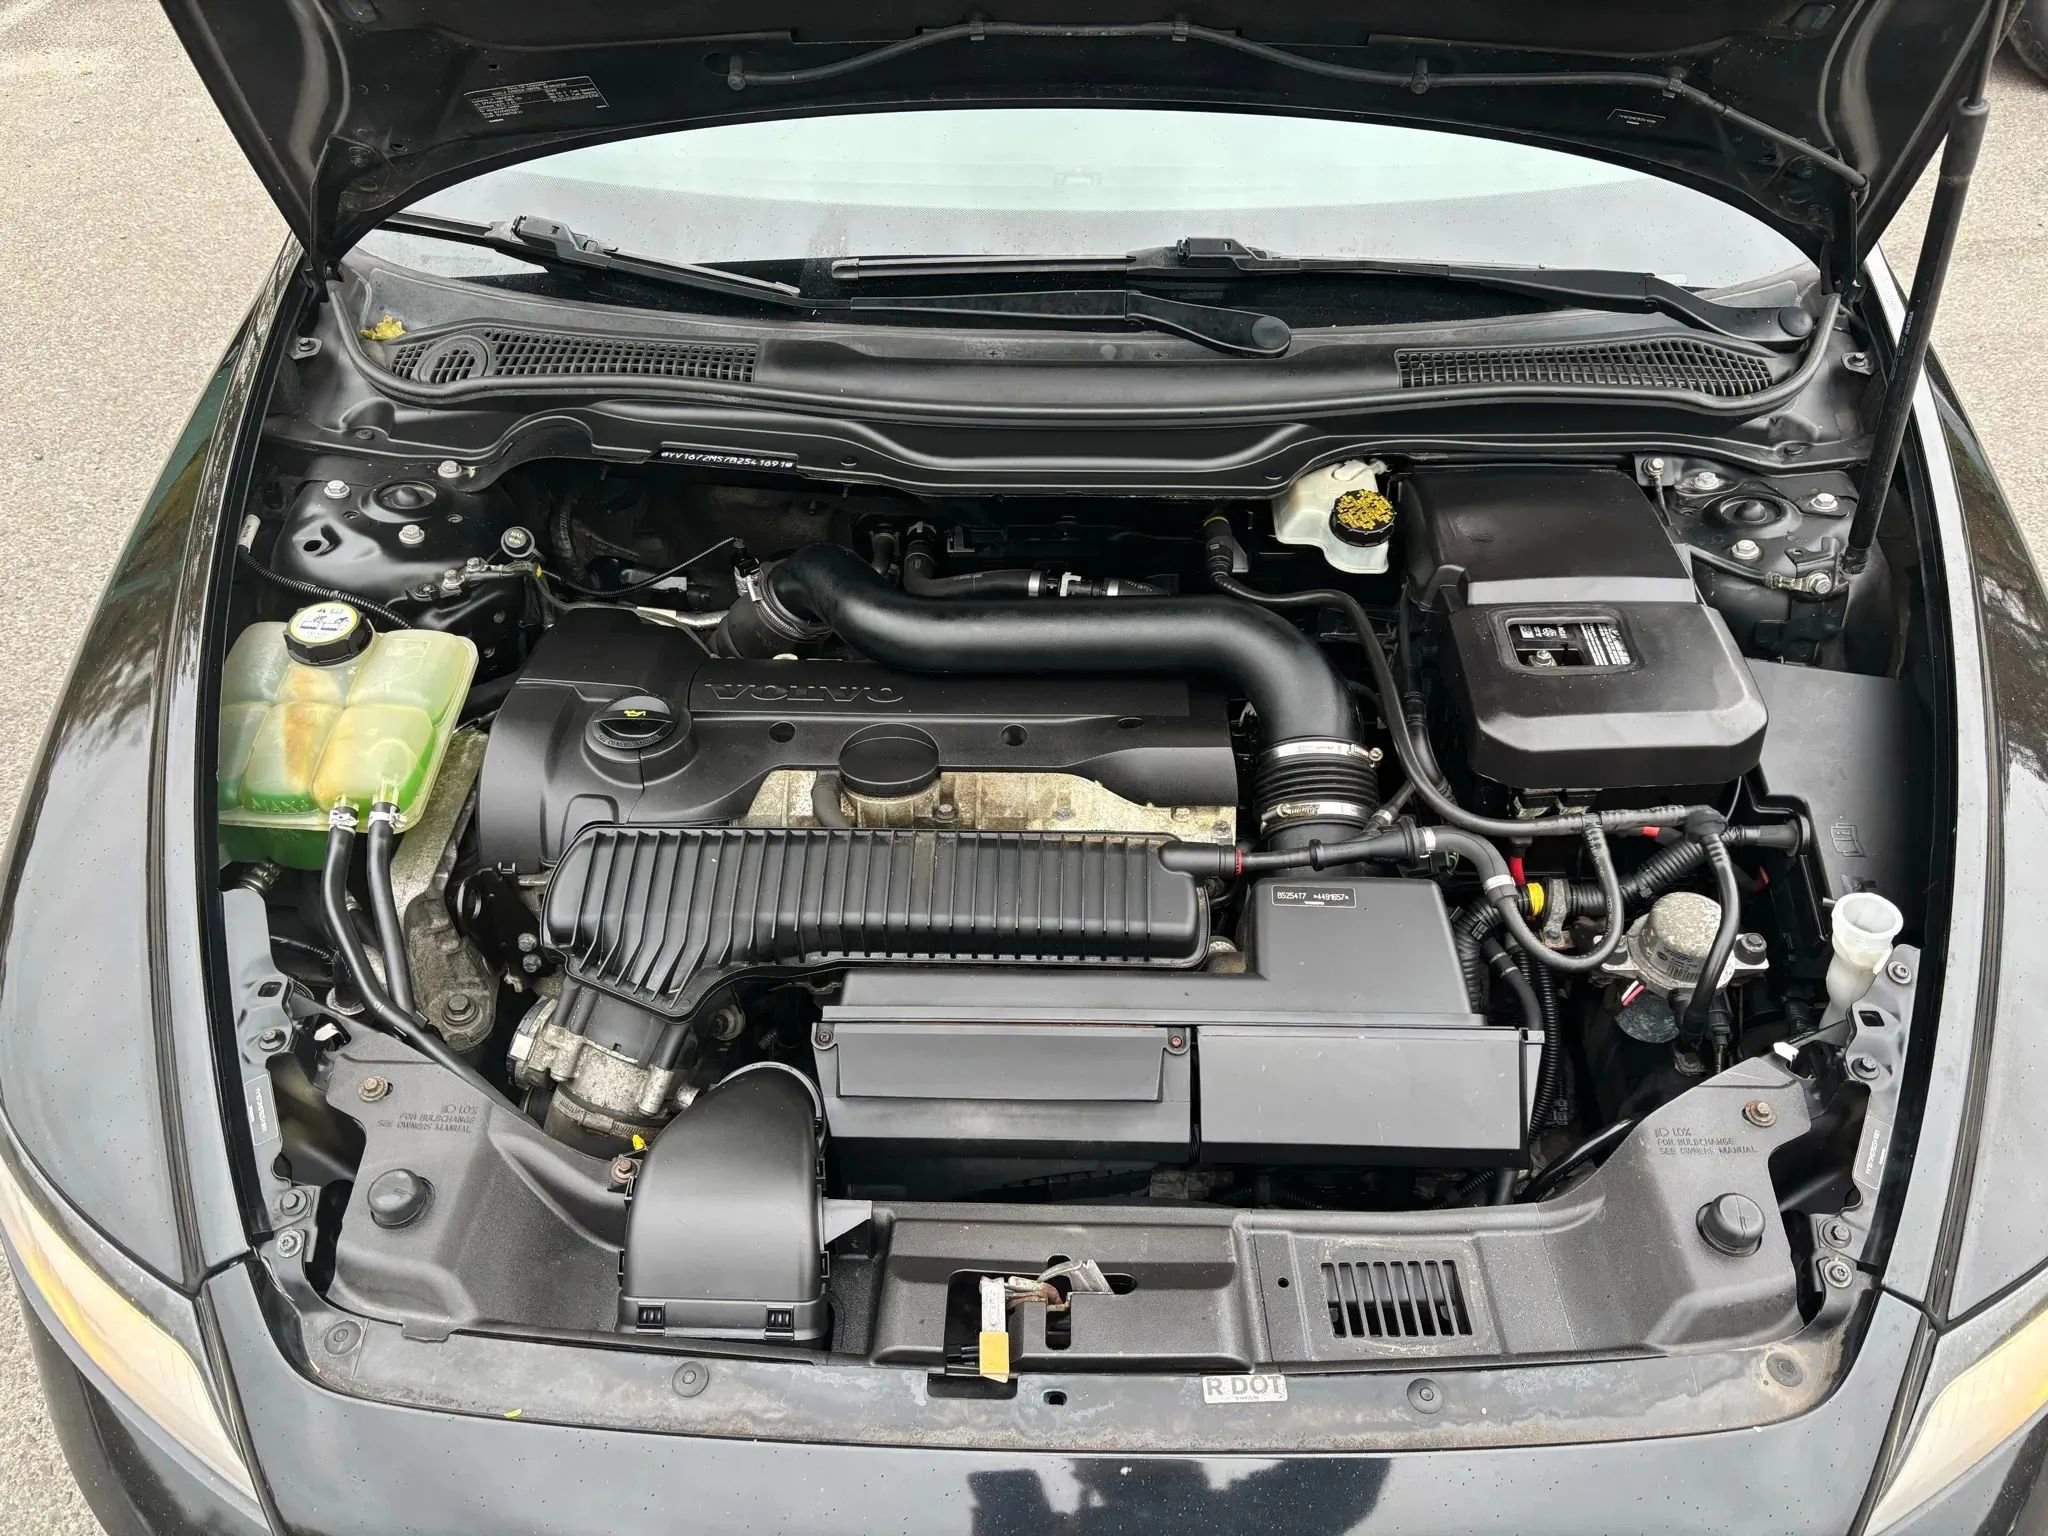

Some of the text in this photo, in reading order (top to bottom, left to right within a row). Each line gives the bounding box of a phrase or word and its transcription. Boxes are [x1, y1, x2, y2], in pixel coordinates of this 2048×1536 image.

[704, 683, 904, 704] VOLVO
[1206, 1375, 1282, 1396] R DOT
